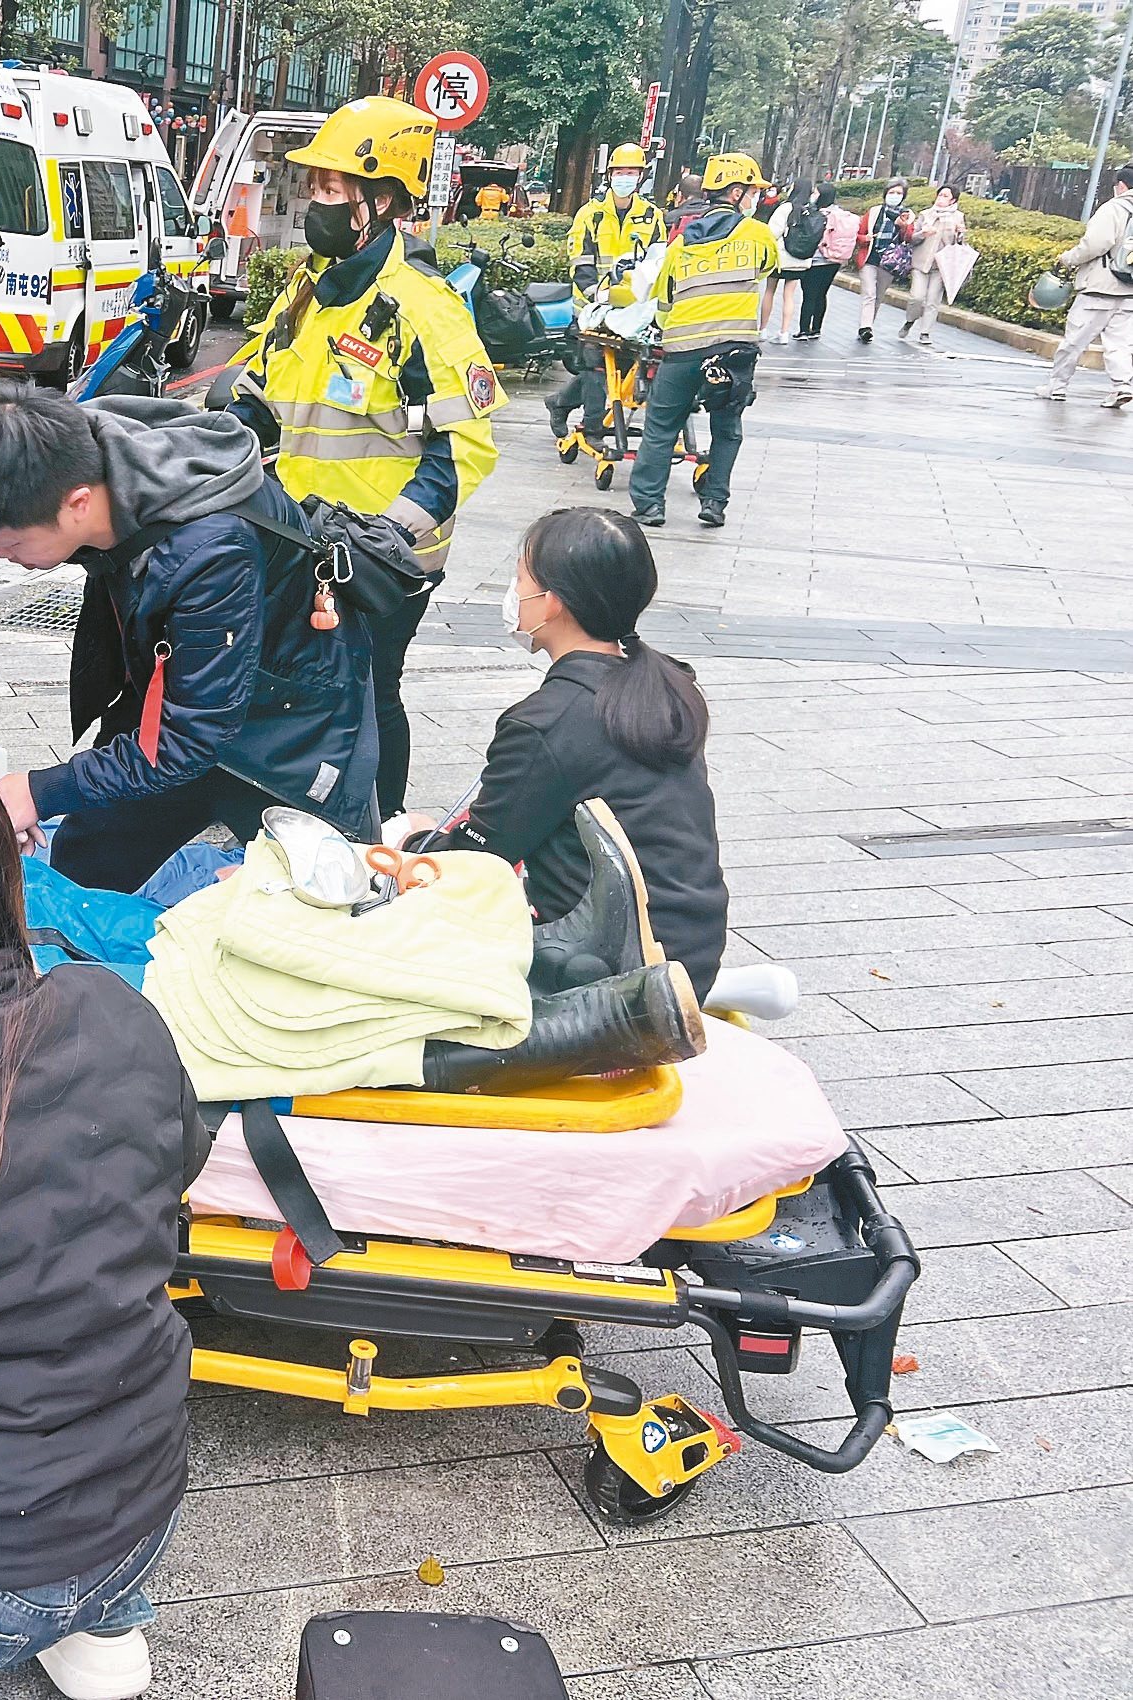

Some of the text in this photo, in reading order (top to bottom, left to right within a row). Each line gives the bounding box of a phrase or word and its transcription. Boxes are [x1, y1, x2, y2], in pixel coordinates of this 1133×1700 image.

[433, 72, 469, 110] 停
[726, 170, 744, 178] EMT
[6, 272, 48, 298] 南屯92
[340, 337, 379, 362] EMT-II
